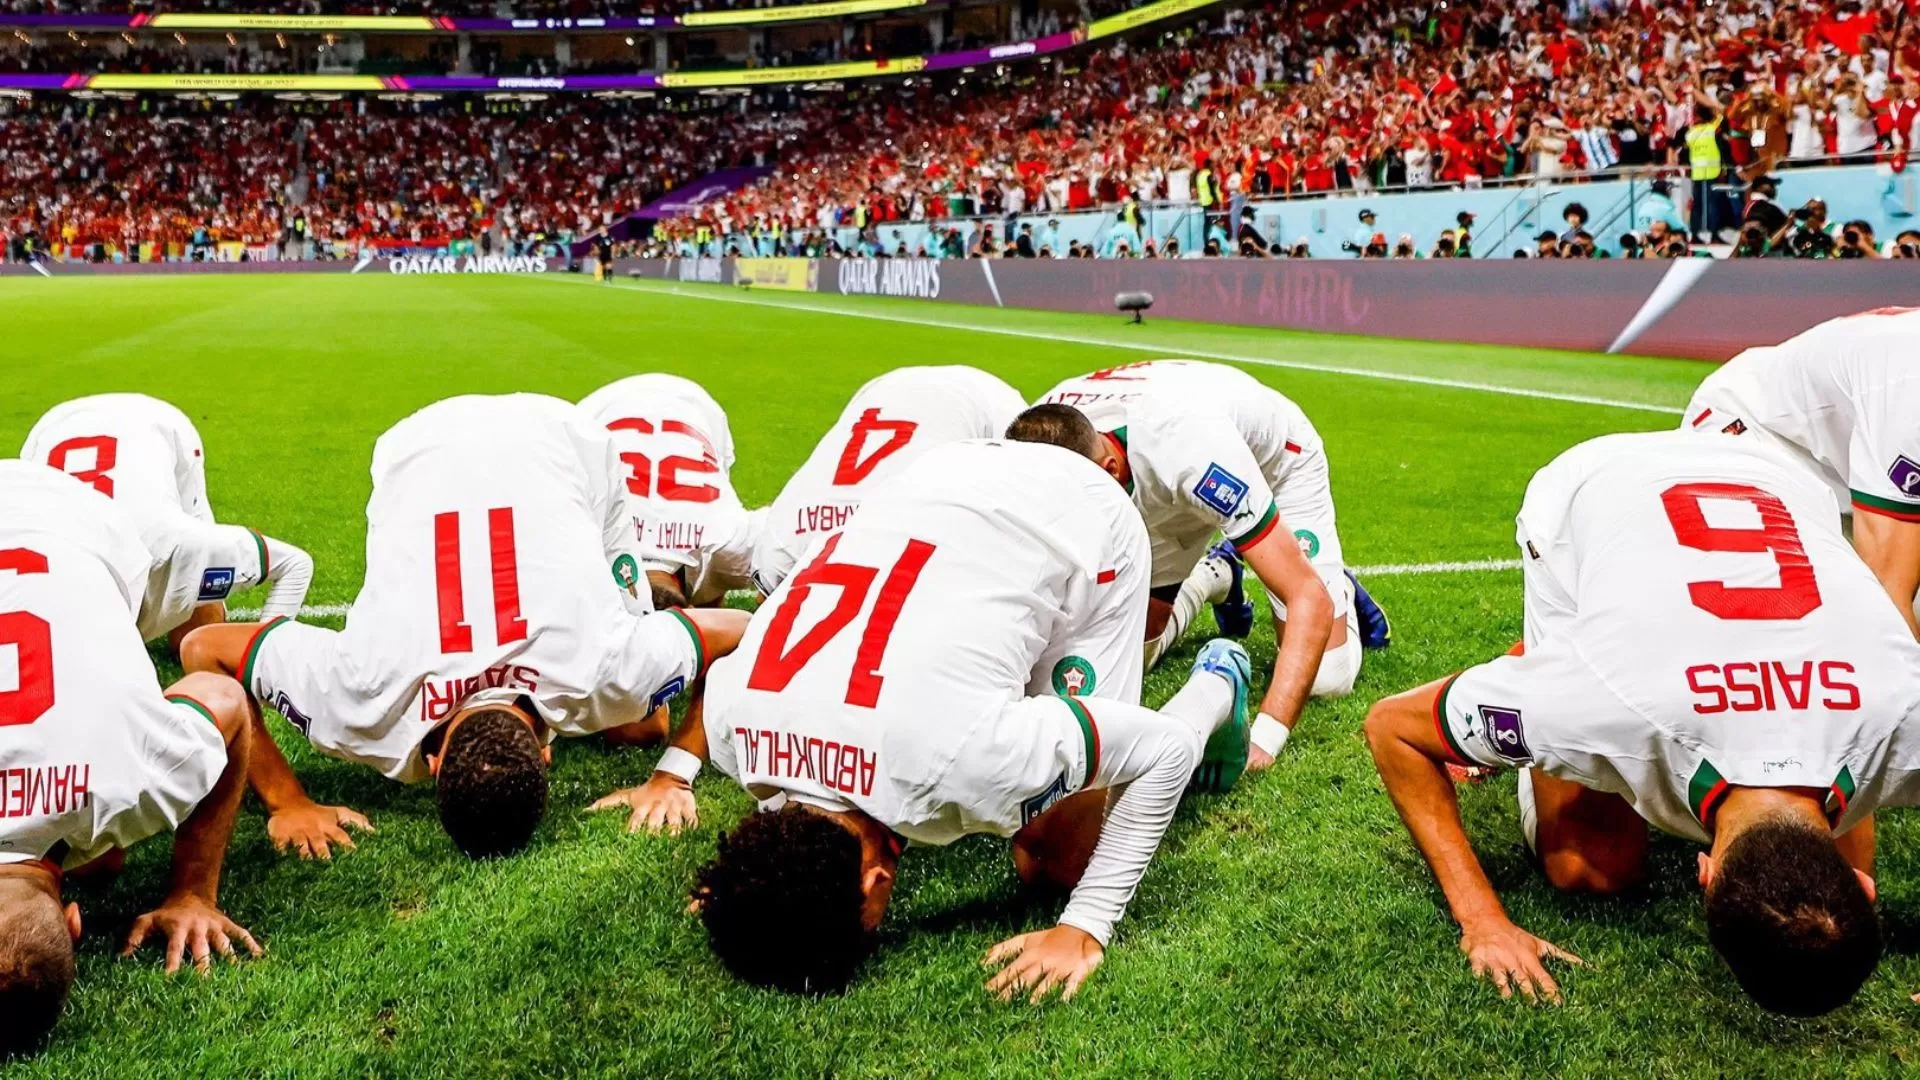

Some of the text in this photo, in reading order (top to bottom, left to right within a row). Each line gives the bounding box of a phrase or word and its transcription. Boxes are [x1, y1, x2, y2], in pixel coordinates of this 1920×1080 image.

[389, 254, 547, 274] QATAR AIRWAYS
[838, 258, 940, 298] QATAR AIRWAYS
[831, 407, 919, 487] 4
[795, 504, 859, 535] ABAT
[1659, 481, 1824, 622] 6
[434, 506, 529, 655] 11
[746, 531, 937, 710] 14
[420, 664, 539, 721] SABIRI
[1684, 659, 1862, 716] SAISS
[735, 726, 878, 798] ABOUKHLAL
